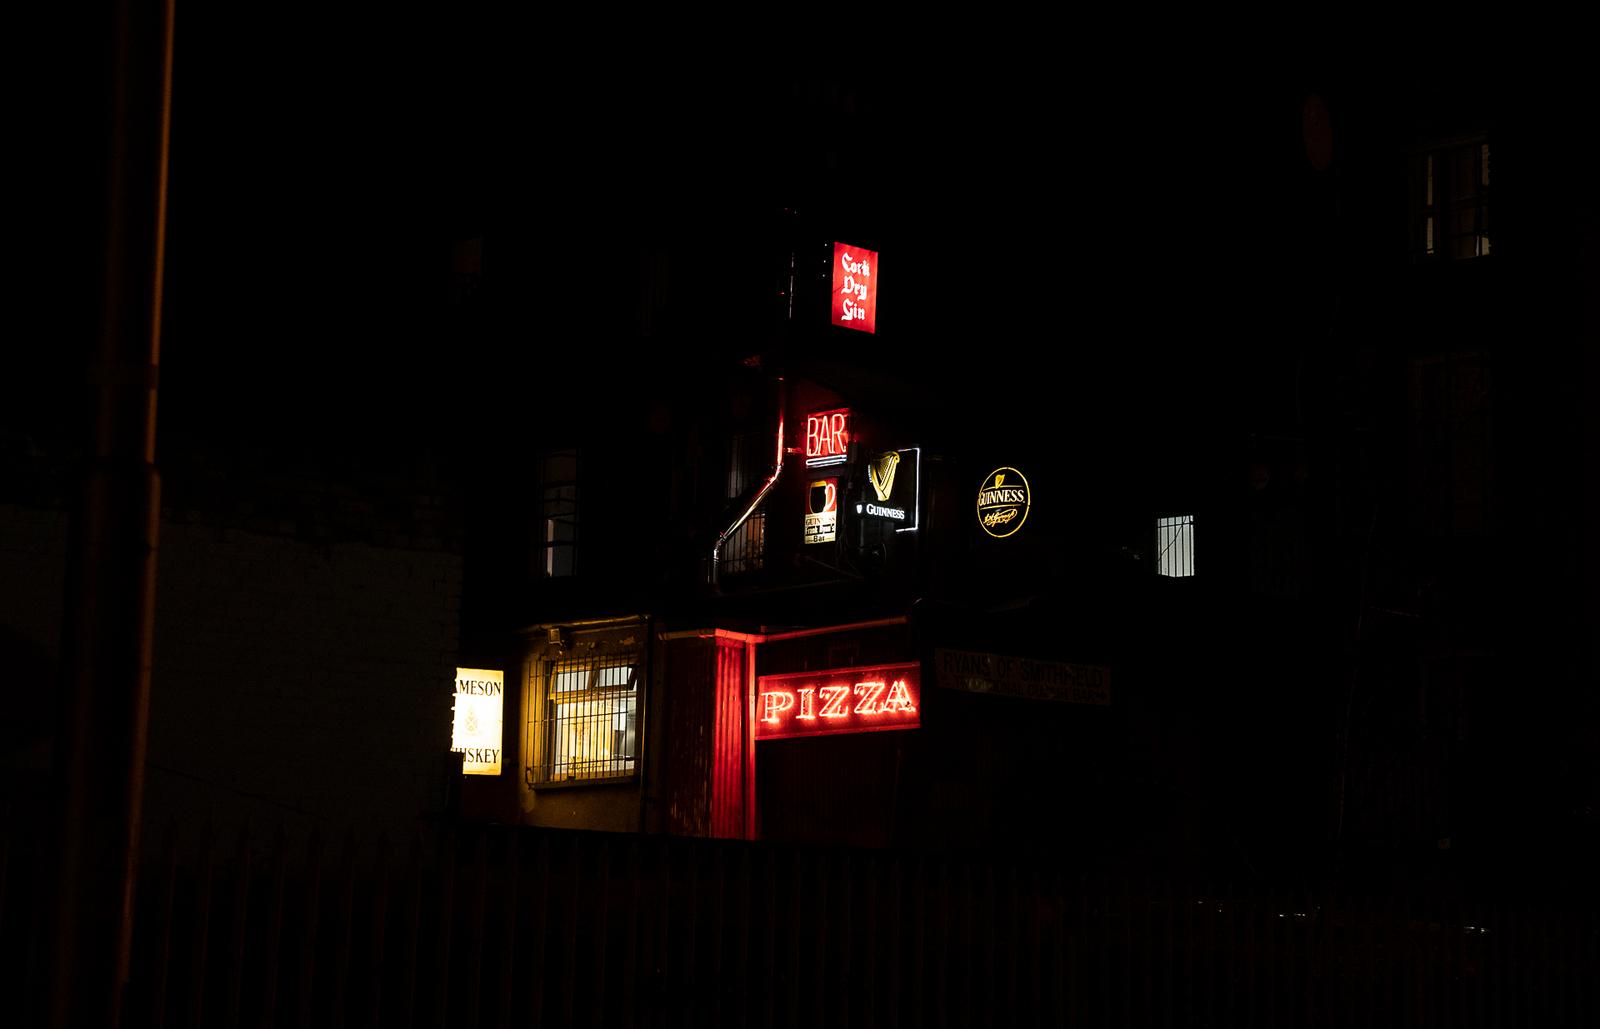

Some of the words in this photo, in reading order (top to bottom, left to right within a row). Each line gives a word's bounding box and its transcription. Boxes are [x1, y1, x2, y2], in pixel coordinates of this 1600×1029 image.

[841, 252, 870, 277] Cork
[841, 275, 867, 300] Dry
[841, 298, 866, 320] Gin
[806, 413, 847, 457] BAR
[977, 489, 1024, 506] GUINNESS
[866, 503, 905, 519] GUINNESS
[943, 651, 990, 677] RYANS
[459, 680, 501, 696] MESON
[760, 678, 917, 723] PIZZA
[455, 747, 500, 763] ISKEY
